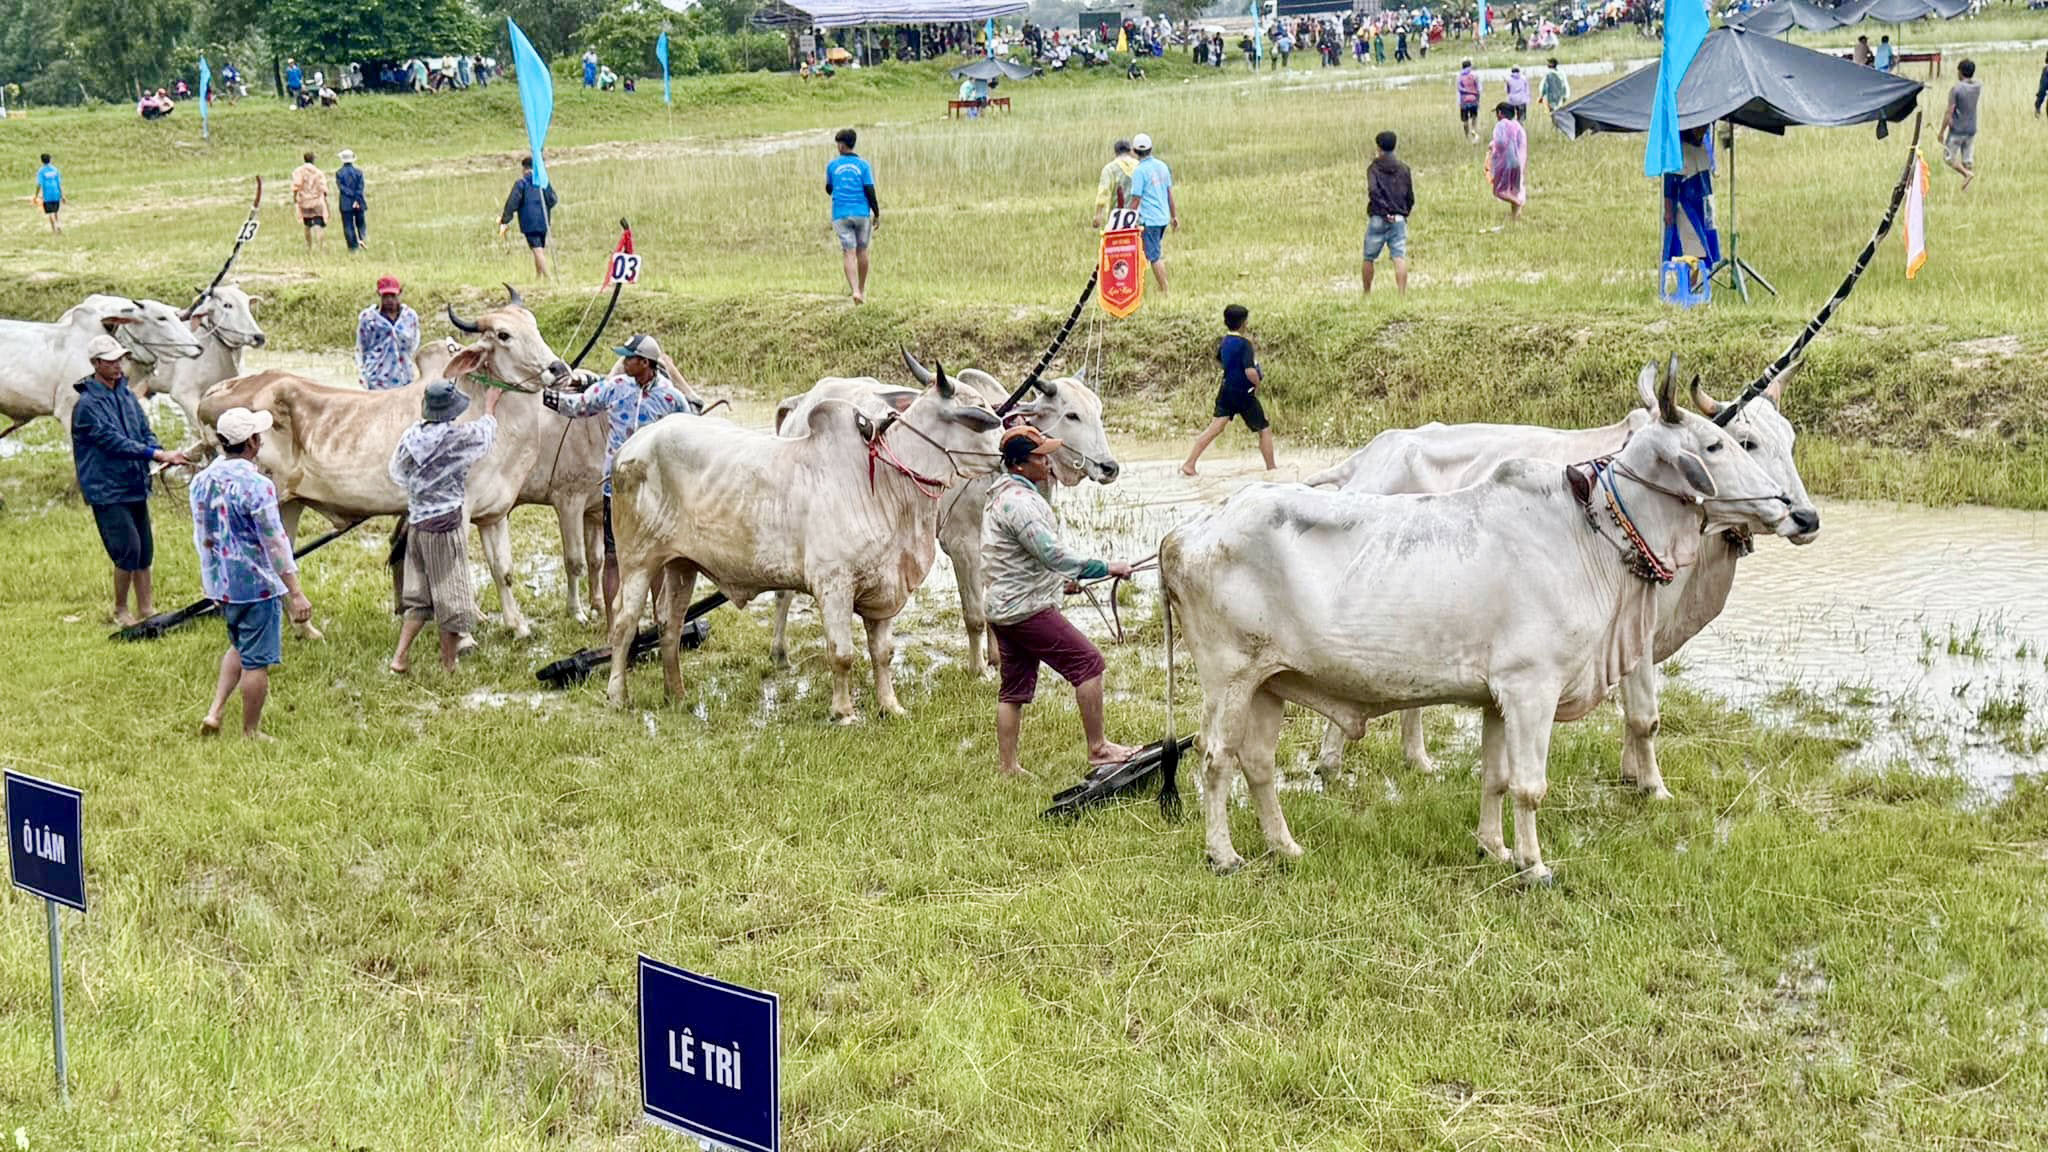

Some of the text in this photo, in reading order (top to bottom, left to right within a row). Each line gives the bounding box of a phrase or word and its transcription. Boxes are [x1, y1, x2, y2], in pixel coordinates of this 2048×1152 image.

[238, 222, 257, 240] 13
[612, 255, 638, 281] 03
[23, 818, 66, 865] Ô LÂM
[668, 1027, 742, 1091] LÊ TRÌ
